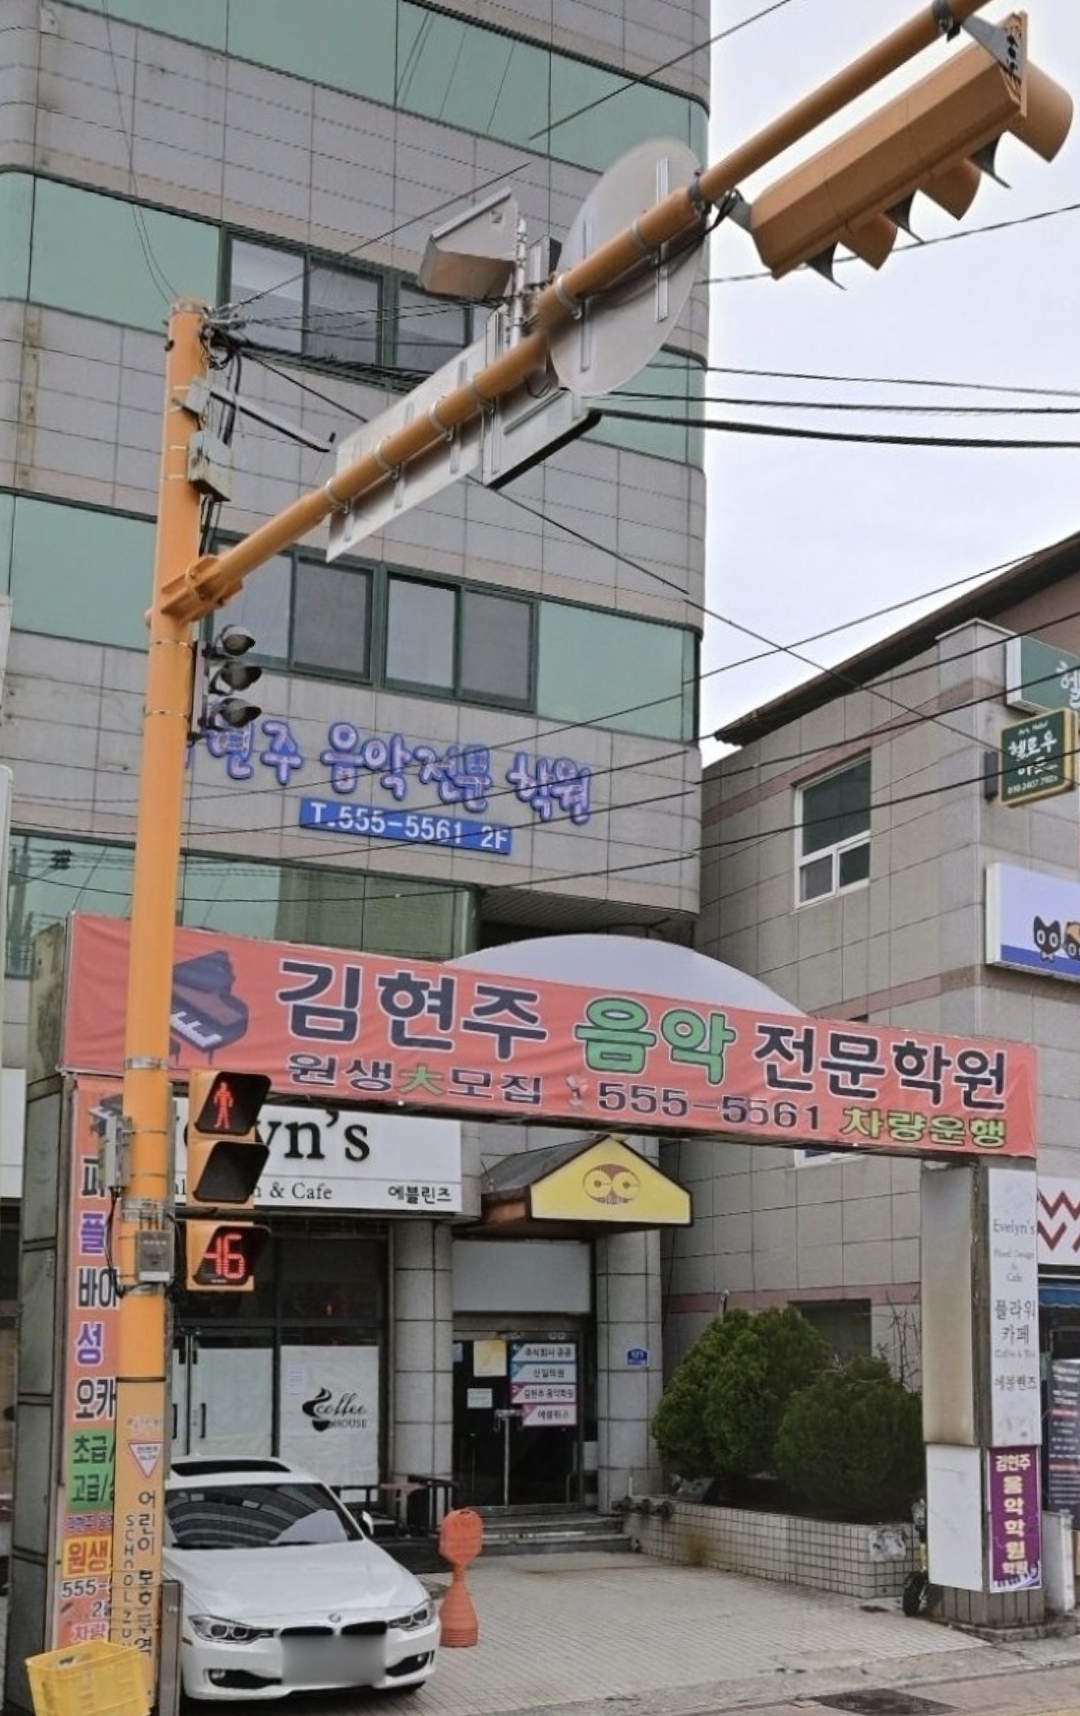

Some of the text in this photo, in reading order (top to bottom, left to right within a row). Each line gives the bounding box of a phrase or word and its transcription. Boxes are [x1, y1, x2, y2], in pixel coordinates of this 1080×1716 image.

[184, 718, 304, 786] 현주
[506, 751, 592, 826] 학원
[481, 825, 510, 850] 2F
[278, 960, 1006, 1110] 김현주 음악 전문학원
[598, 1081, 819, 1131] 555-5561
[842, 1106, 1006, 1148] 차량운행
[269, 1182, 285, 1199] &
[291, 1182, 333, 1200] Cafe
[388, 1185, 453, 1205] 에블린즈
[993, 1218, 1035, 1237] Evelyn's
[995, 1299, 1036, 1321] 플라워
[1001, 1324, 1029, 1346] 카페
[137, 1489, 155, 1556] 어린이
